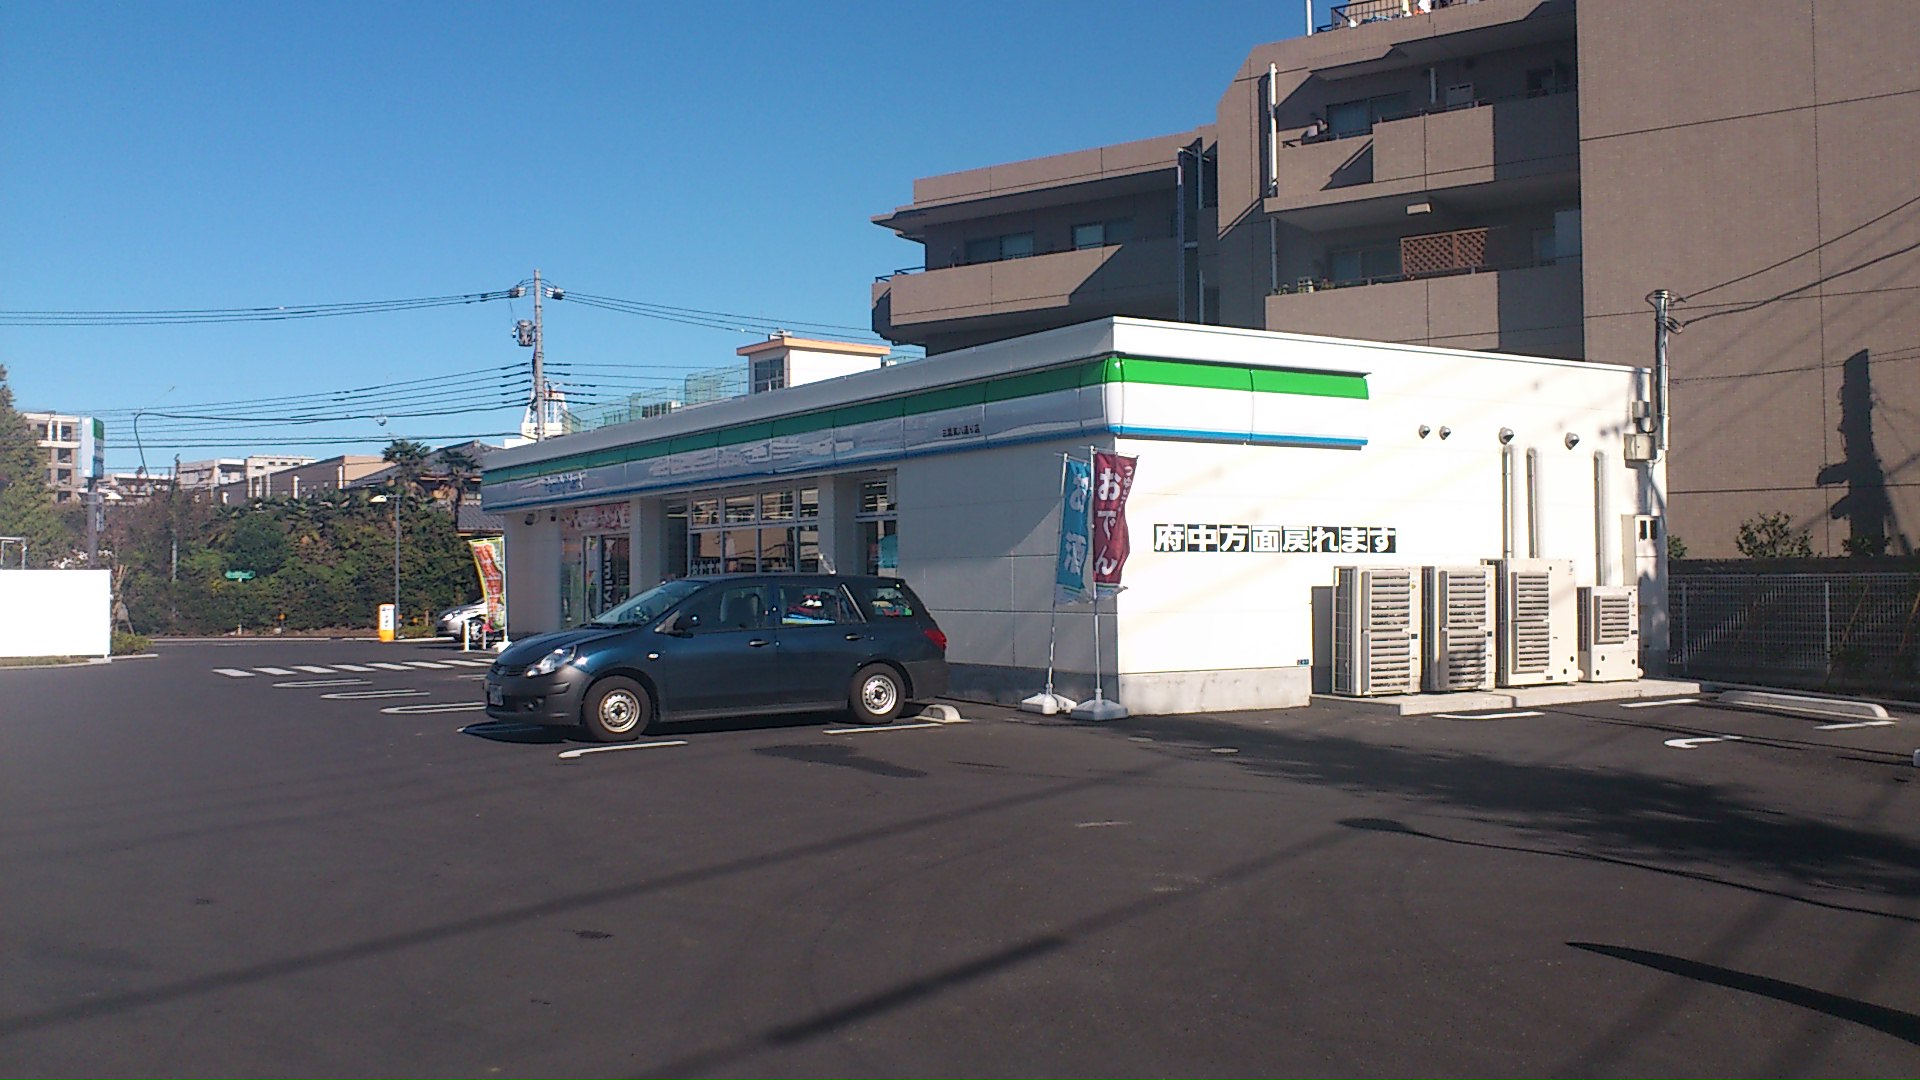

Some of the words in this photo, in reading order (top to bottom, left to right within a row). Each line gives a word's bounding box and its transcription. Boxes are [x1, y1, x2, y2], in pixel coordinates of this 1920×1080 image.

[1095, 467, 1122, 576] おでん
[1154, 523, 1396, 553] 府中方面戻れます
